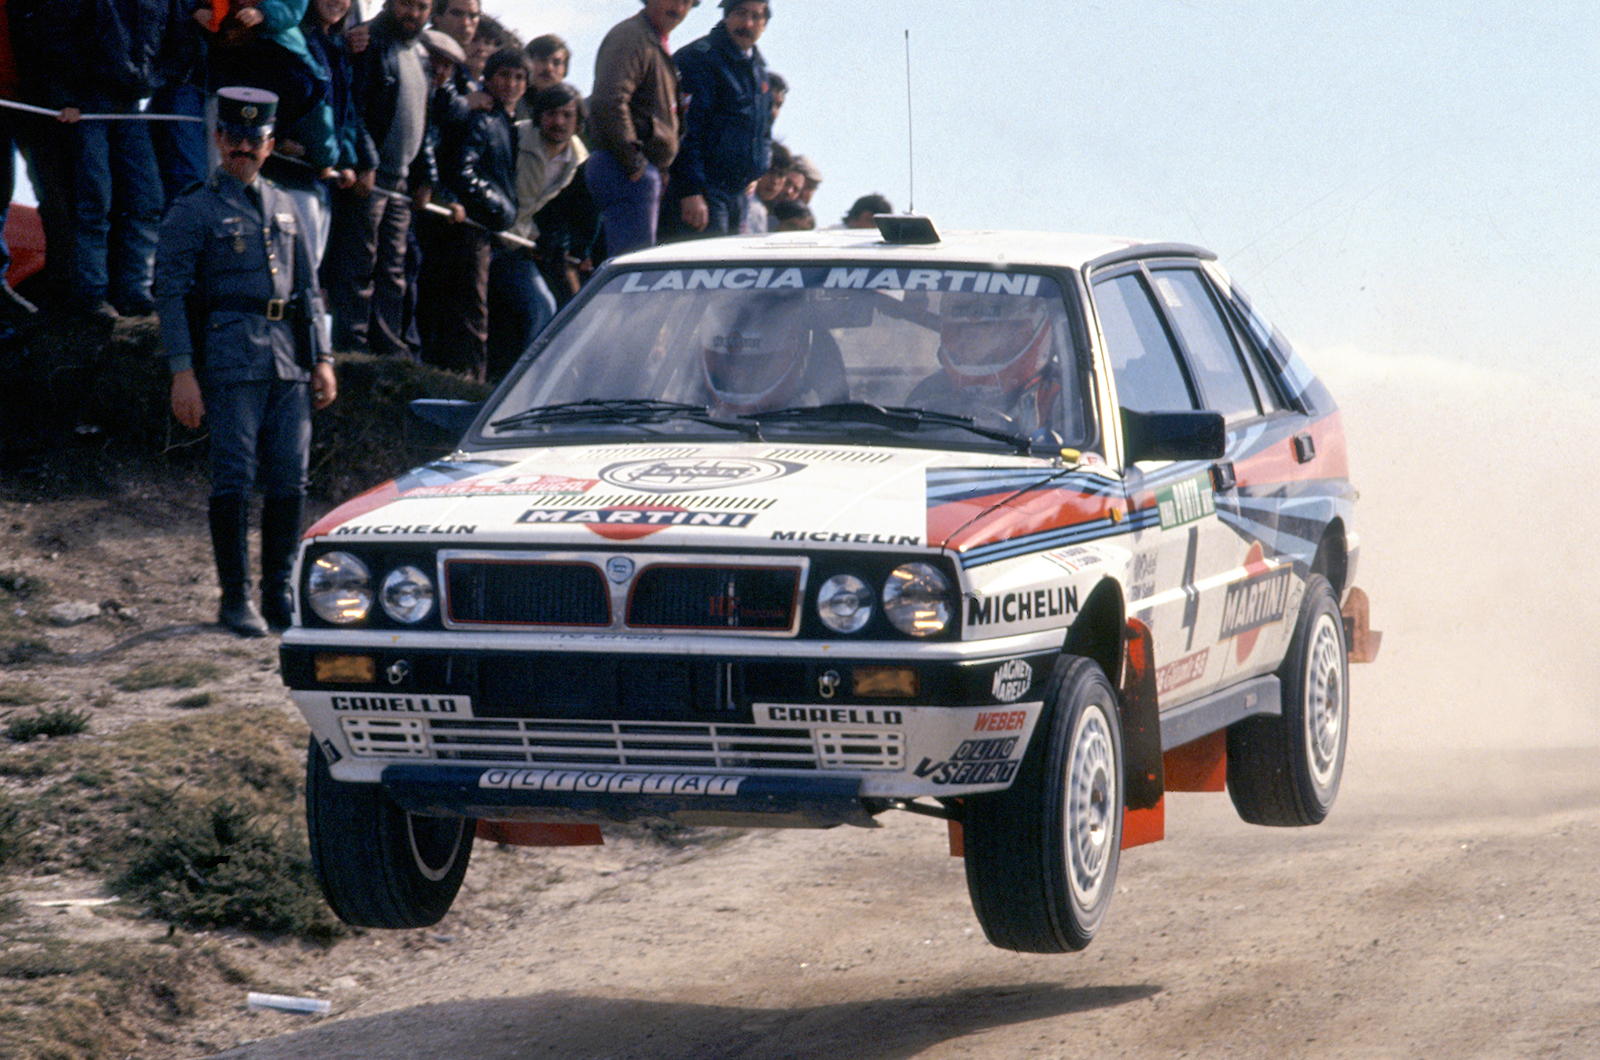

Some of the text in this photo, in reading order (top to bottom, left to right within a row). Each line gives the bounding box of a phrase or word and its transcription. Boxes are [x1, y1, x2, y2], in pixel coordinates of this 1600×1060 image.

[622, 267, 1041, 296] LANCIA MARTINI
[528, 510, 749, 527] MARTINI
[336, 525, 477, 536] MICHELIN
[770, 531, 921, 546] MICHELIN
[967, 585, 1078, 626] MICHELIN
[1222, 573, 1290, 634] MARTINI
[993, 659, 1032, 681] MAGNETI
[992, 679, 1031, 702] MARELLI
[331, 696, 456, 713] CARELLO
[768, 706, 903, 725] CARELLO
[973, 710, 1027, 732] WEBER
[953, 738, 1017, 760] OLIO
[954, 761, 1017, 784] FIAT
